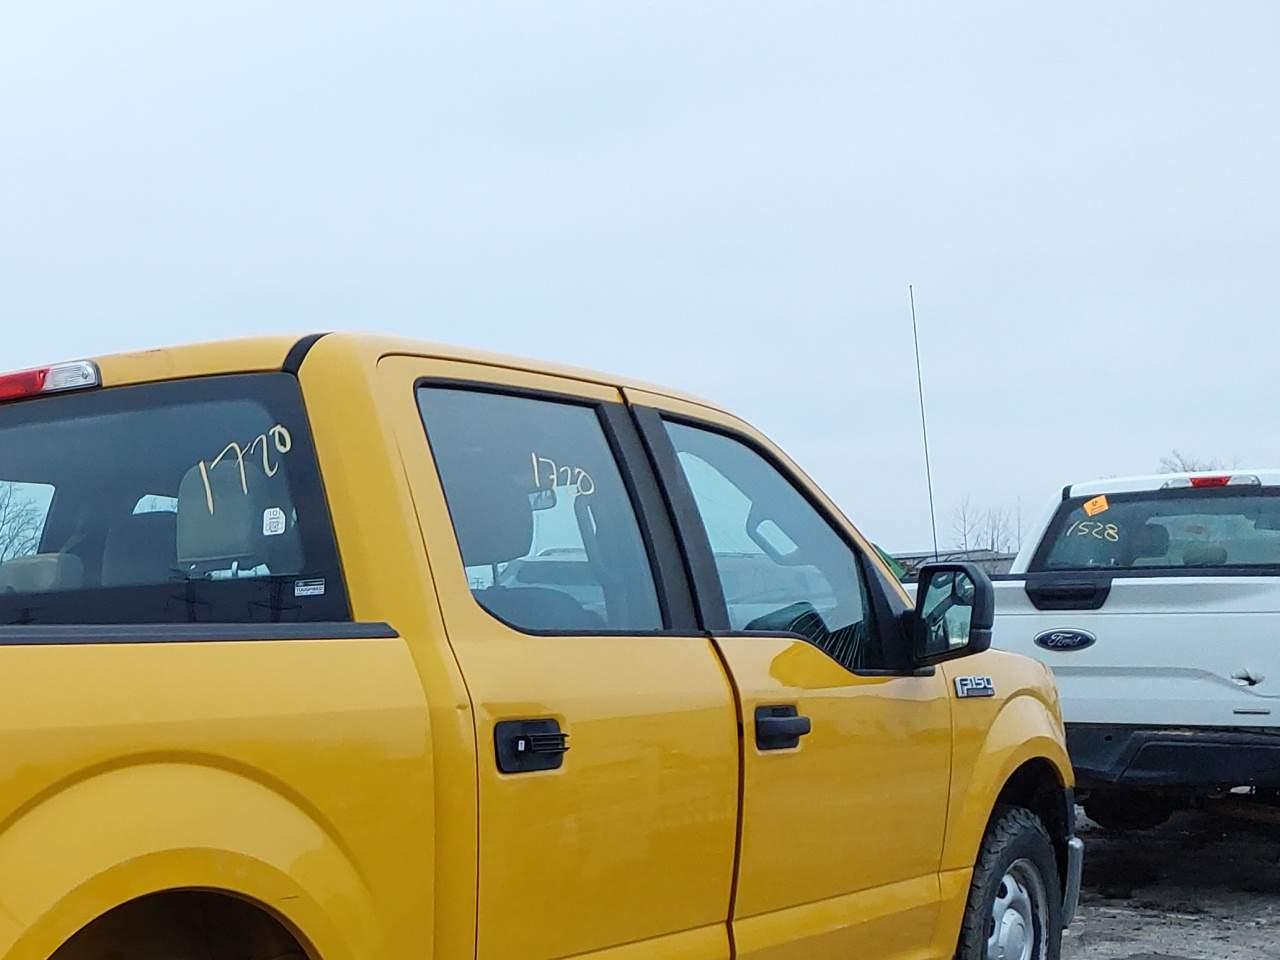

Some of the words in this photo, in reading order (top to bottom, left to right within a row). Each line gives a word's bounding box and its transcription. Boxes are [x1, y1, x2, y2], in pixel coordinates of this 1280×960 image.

[199, 424, 292, 516] 1720
[531, 451, 595, 496] 1720
[1066, 519, 1120, 542] 1528
[1047, 632, 1081, 646] Ford
